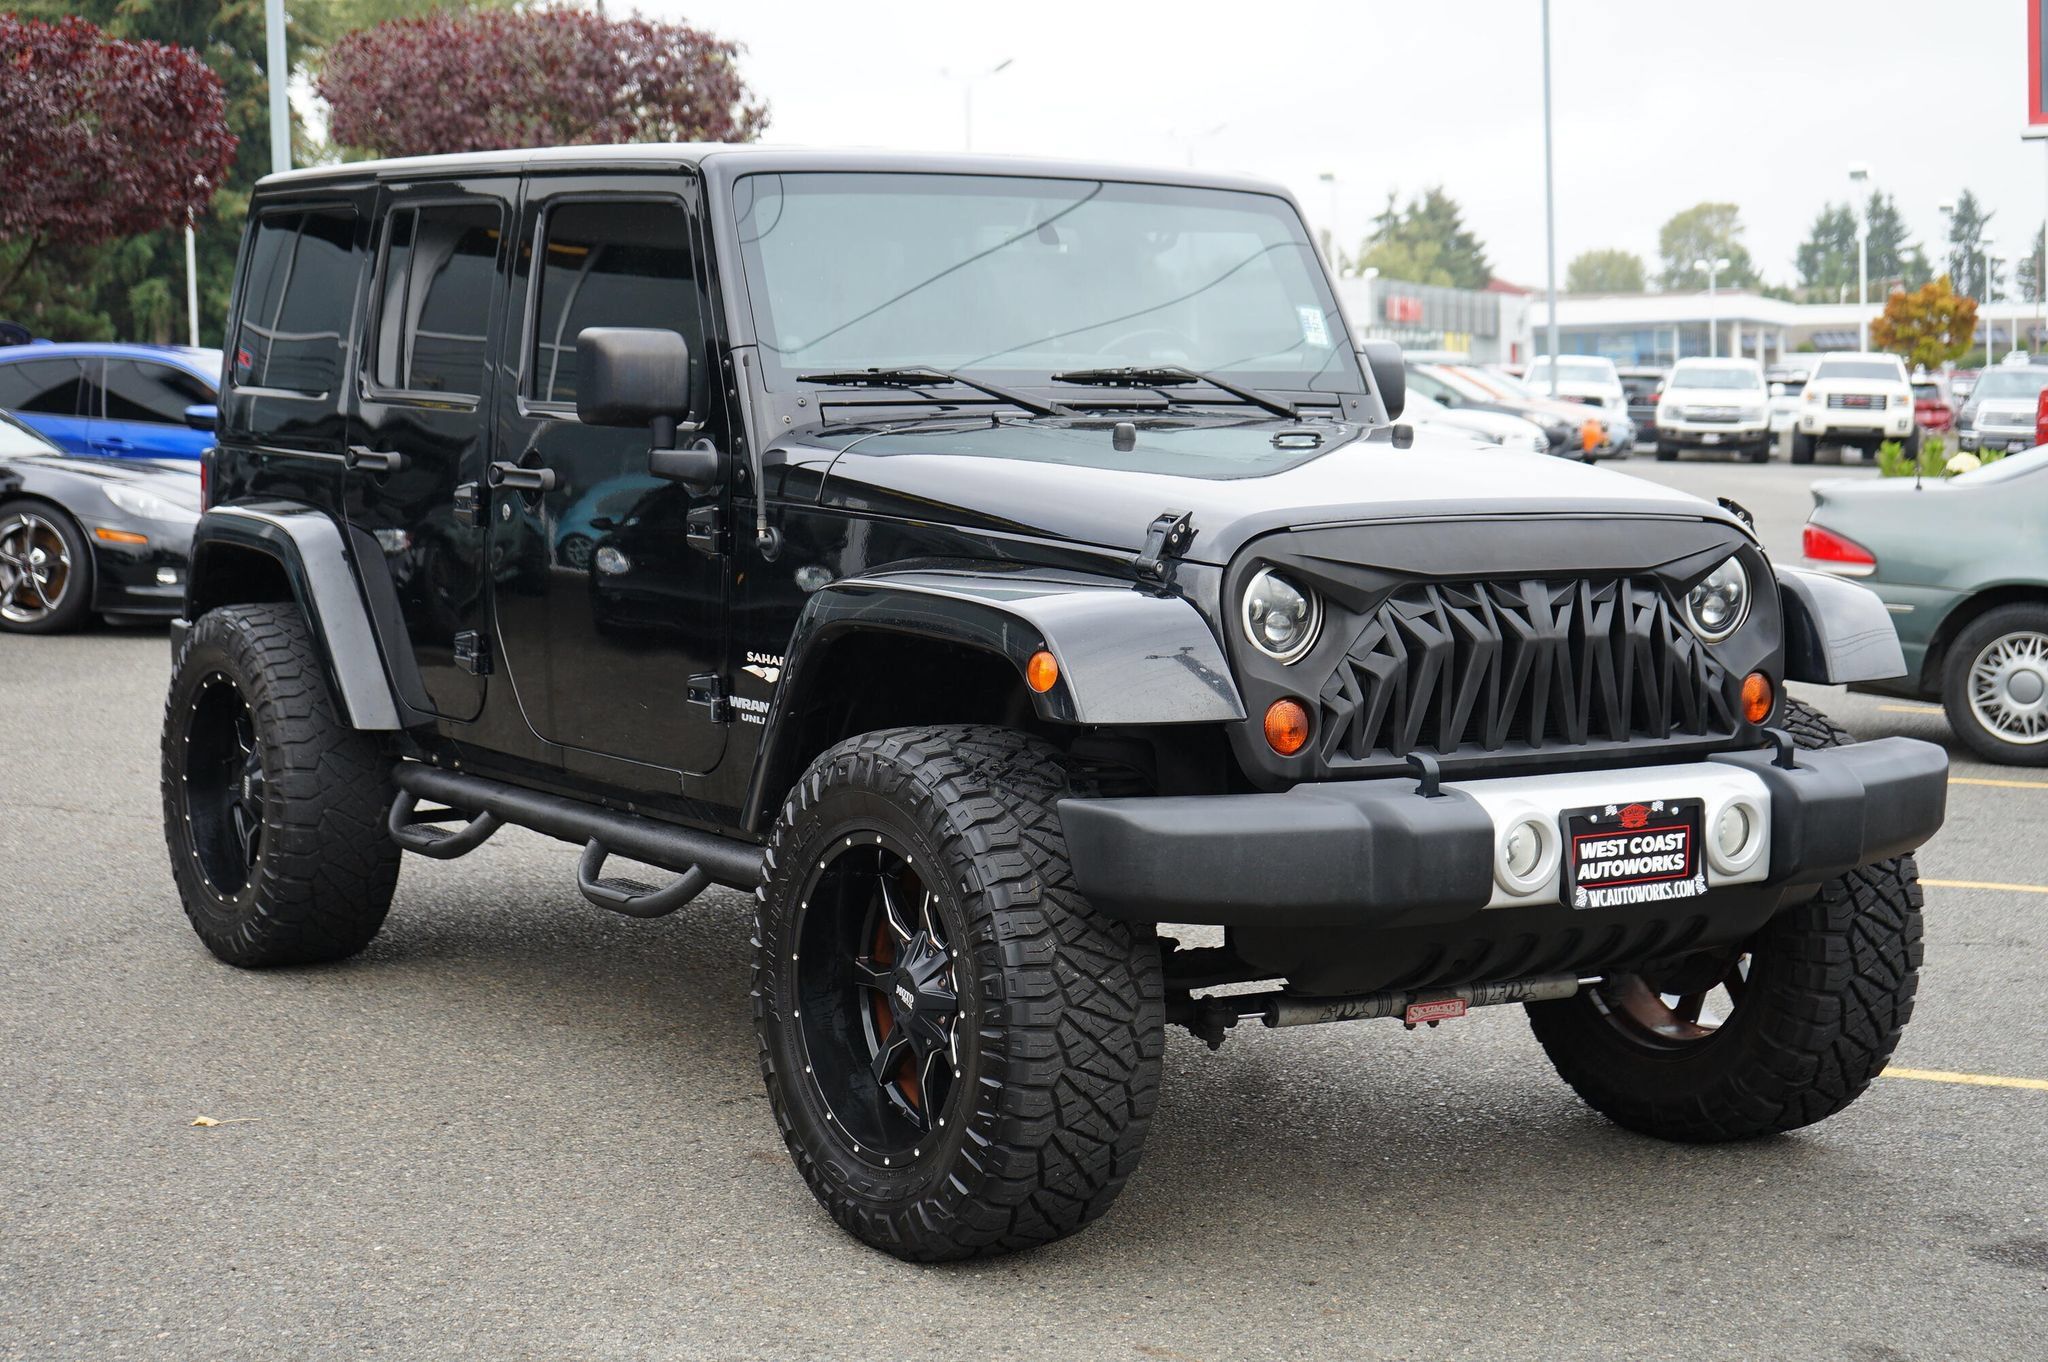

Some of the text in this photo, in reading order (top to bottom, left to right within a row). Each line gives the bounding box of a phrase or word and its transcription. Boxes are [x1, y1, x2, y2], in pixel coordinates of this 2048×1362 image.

[729, 695, 770, 713] WRAN
[741, 712, 766, 725] UNLI
[1580, 832, 1686, 859] WEST COAST
[1577, 853, 1685, 881] AUTOWORKS
[1587, 879, 1696, 907] WCAUTOWORKS.COM
